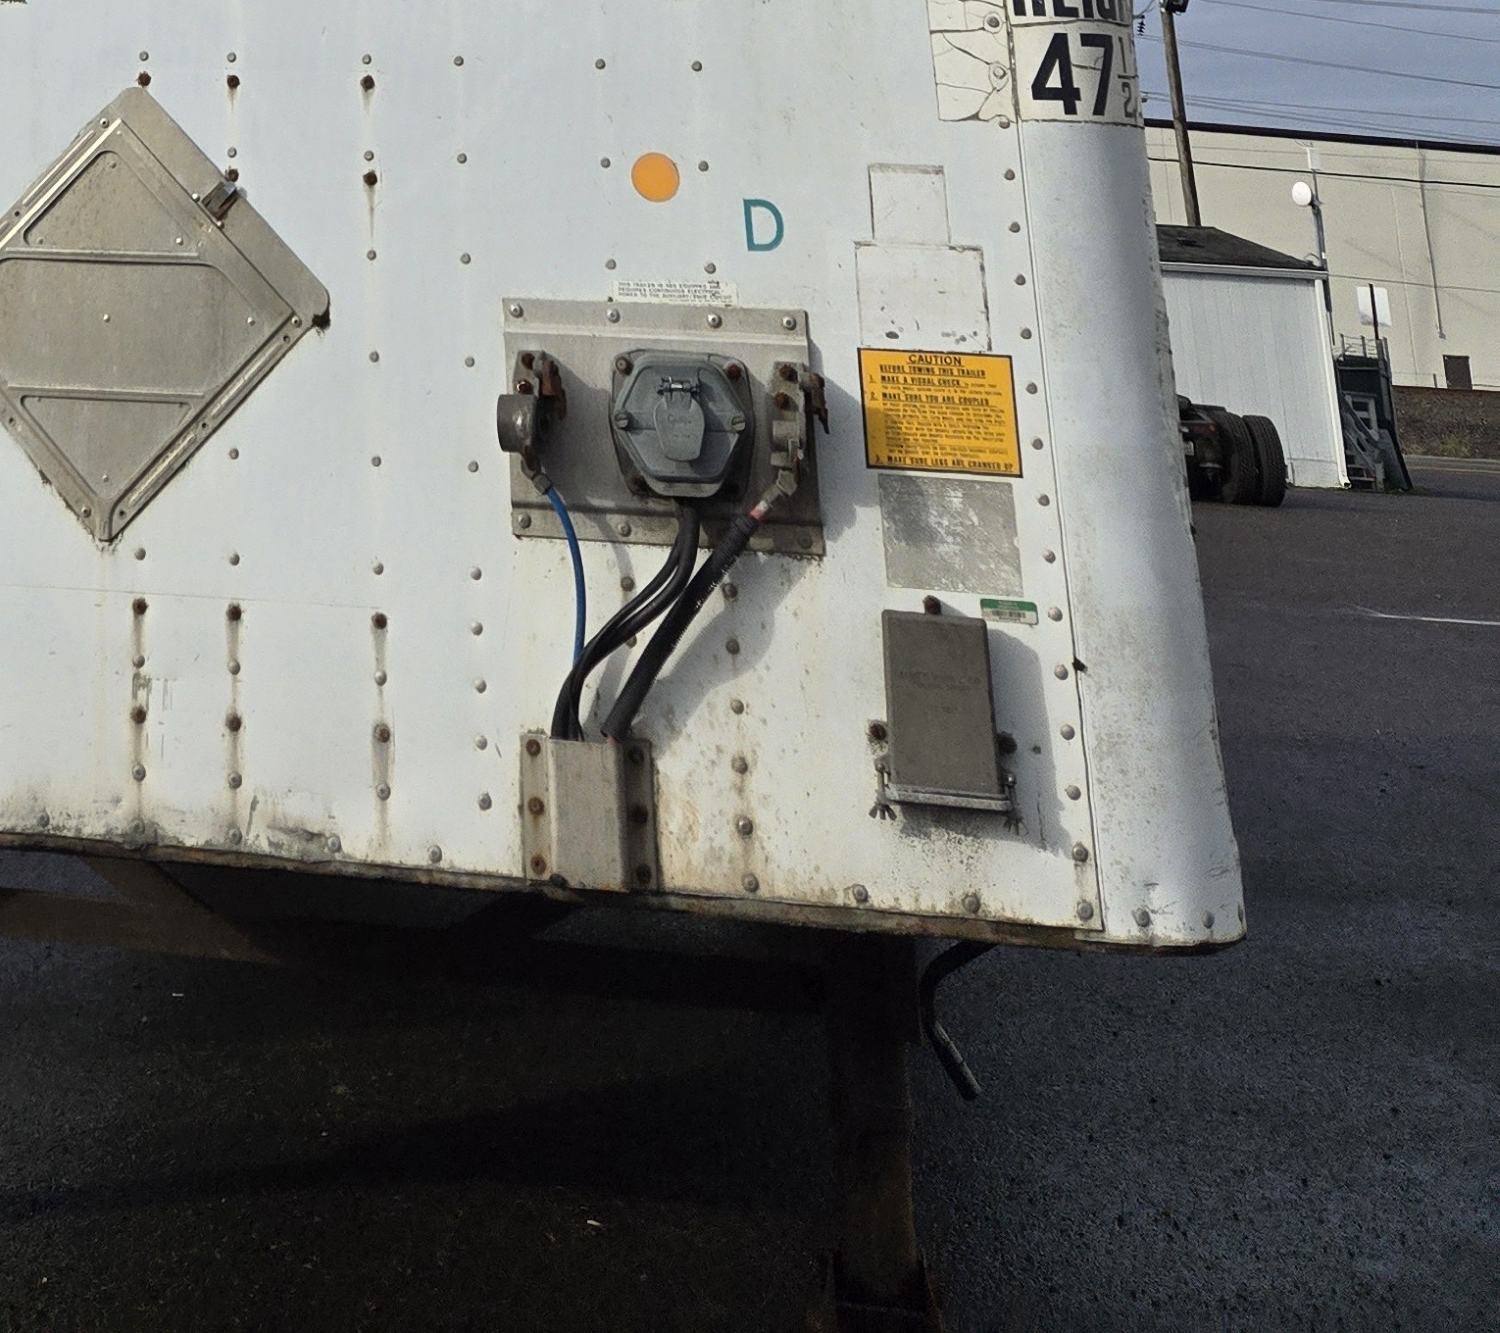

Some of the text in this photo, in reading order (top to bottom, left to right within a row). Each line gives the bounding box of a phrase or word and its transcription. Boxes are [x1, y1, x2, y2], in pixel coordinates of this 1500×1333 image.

[1031, 32, 1113, 116] 47
[743, 199, 784, 251] D
[908, 354, 963, 365] CAUTION
